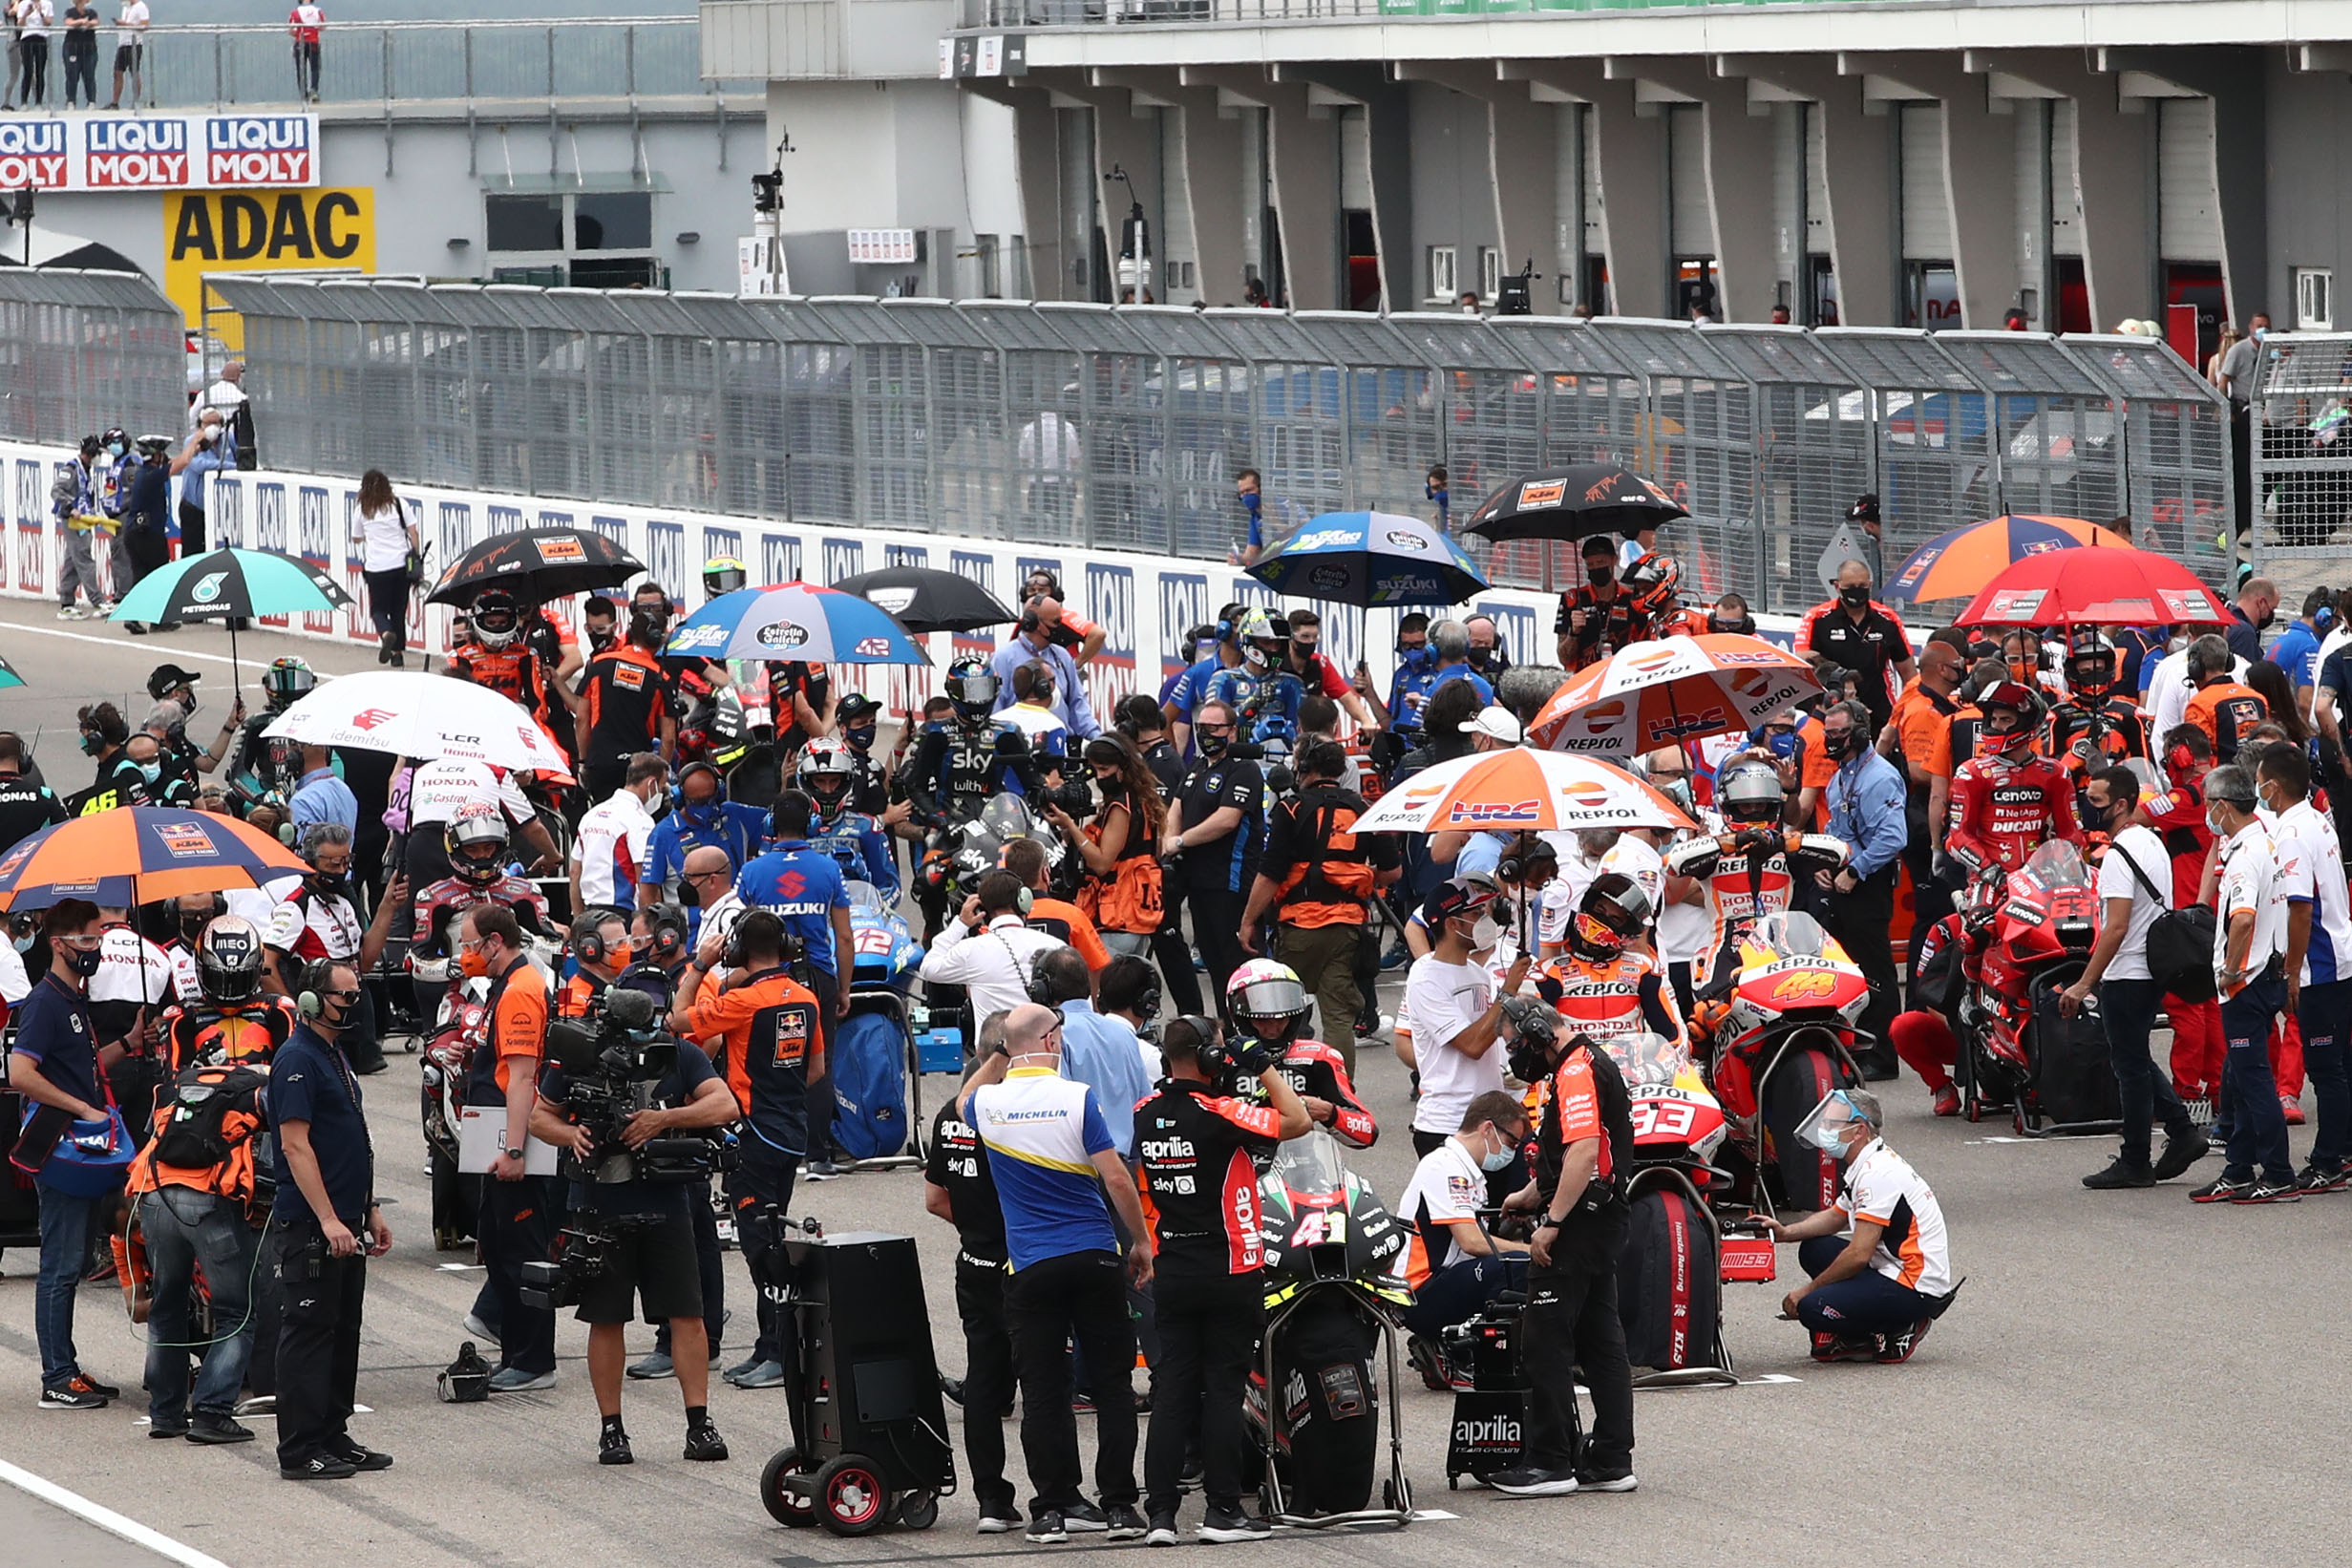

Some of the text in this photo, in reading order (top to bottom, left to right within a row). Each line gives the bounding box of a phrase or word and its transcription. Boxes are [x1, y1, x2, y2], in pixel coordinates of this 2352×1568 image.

[91, 122, 183, 152] LIQUI
[211, 116, 307, 149] LIQUI
[91, 155, 185, 184] MOLY
[212, 152, 307, 182] MOLY
[172, 192, 360, 261] ADAC
[17, 465, 42, 524] LIQUI
[257, 484, 285, 550] LIQUI
[300, 491, 329, 558] LIQUI
[1300, 530, 1362, 544] SUZUKI
[19, 529, 43, 585] MOLY
[1376, 579, 1438, 590] SUZUKI
[181, 603, 231, 614] PETRONAS
[1089, 570, 1134, 654] LIQUI
[679, 627, 730, 642] SUZUKI
[763, 626, 803, 638] Estrella
[763, 634, 801, 646] Galicia
[855, 638, 890, 657] 42
[1712, 650, 1786, 663] HRC
[1621, 664, 1691, 687] REPSOL
[1749, 685, 1800, 716] REPSOL
[1647, 706, 1727, 741] HRC
[330, 729, 390, 748] idemitsu
[441, 732, 481, 746] LCR
[1566, 736, 1623, 751] REPSOL
[443, 748, 486, 759] Honda
[952, 748, 993, 774] sky
[422, 778, 479, 788] HONDA
[80, 789, 117, 817] 46
[433, 793, 468, 804] Castrol
[1994, 790, 2043, 802] Lenovo
[1375, 812, 1426, 824] REPSOL
[1451, 799, 1540, 822] HRC
[1569, 807, 1642, 820] REPSOL
[2006, 808, 2040, 817] NetApp
[1992, 819, 2043, 833] DUCATI
[960, 848, 992, 874] sky
[1960, 846, 1981, 865] Lenovo
[451, 893, 470, 904] GIVI
[2005, 903, 2043, 924] Lenovo
[2062, 922, 2088, 930] DUCATI
[216, 939, 247, 951] MEO
[100, 953, 160, 968] HONDA
[1767, 958, 1838, 974] REPSOL
[1771, 970, 1838, 1002] 44
[1744, 1002, 1768, 1017] HRC
[1570, 1022, 1633, 1032] HONDA
[1630, 1087, 1692, 1101] EPSOL
[1006, 1110, 1069, 1121] MICHELIN
[1346, 1115, 1372, 1134] aprilia
[1633, 1102, 1696, 1136] 93
[1141, 1136, 1196, 1161] aprilia
[947, 1157, 964, 1175] sky
[1153, 1177, 1175, 1194] sky
[1235, 1186, 1261, 1266] aprilia
[1291, 1211, 1346, 1248] 41
[1371, 1245, 1388, 1260] sky
[1675, 1254, 1685, 1292] Racing
[1673, 1329, 1685, 1365] KLS
[1455, 1414, 1520, 1446] aprilia
